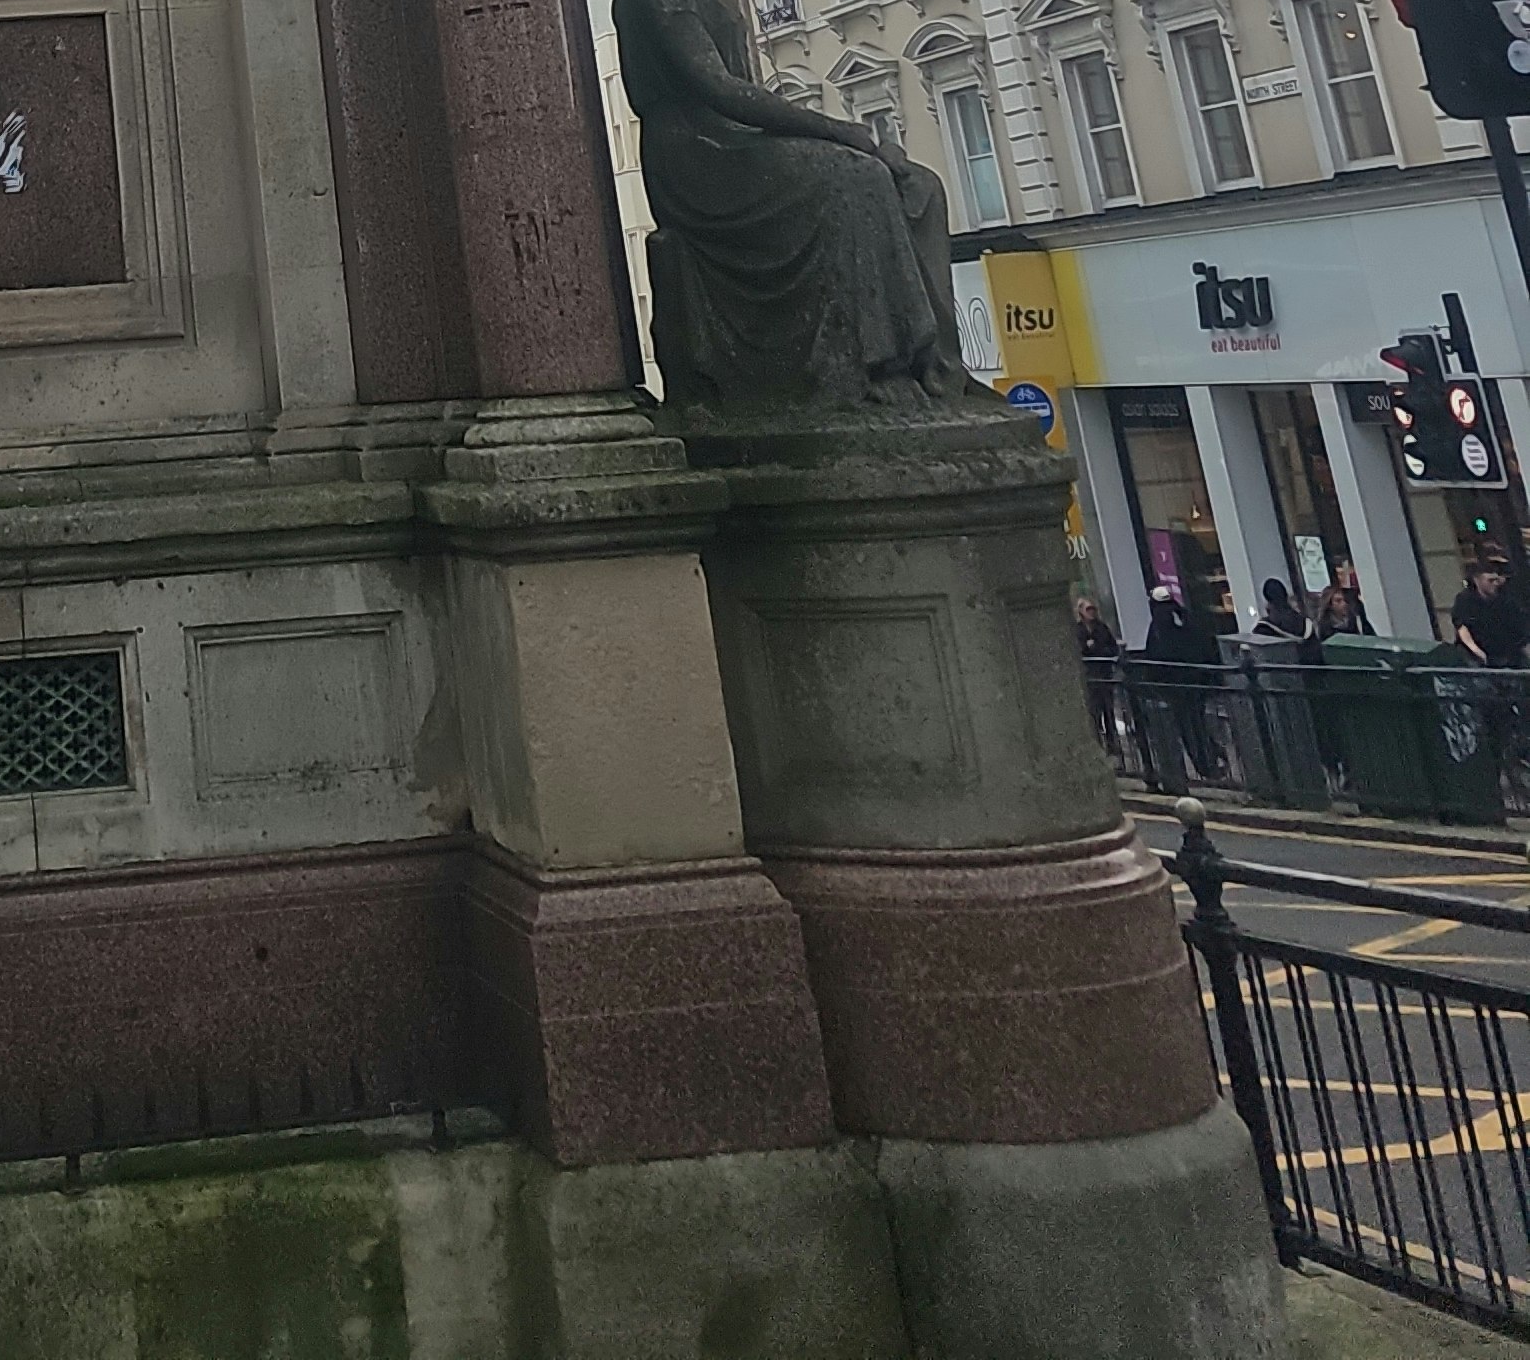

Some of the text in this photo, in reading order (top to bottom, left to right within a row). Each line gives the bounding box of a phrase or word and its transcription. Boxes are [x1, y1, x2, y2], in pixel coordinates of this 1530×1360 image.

[1272, 80, 1298, 95] STREET
[1191, 261, 1274, 331] itsu
[1005, 302, 1055, 333] itsu
[1211, 333, 1282, 353] eat beautiful
